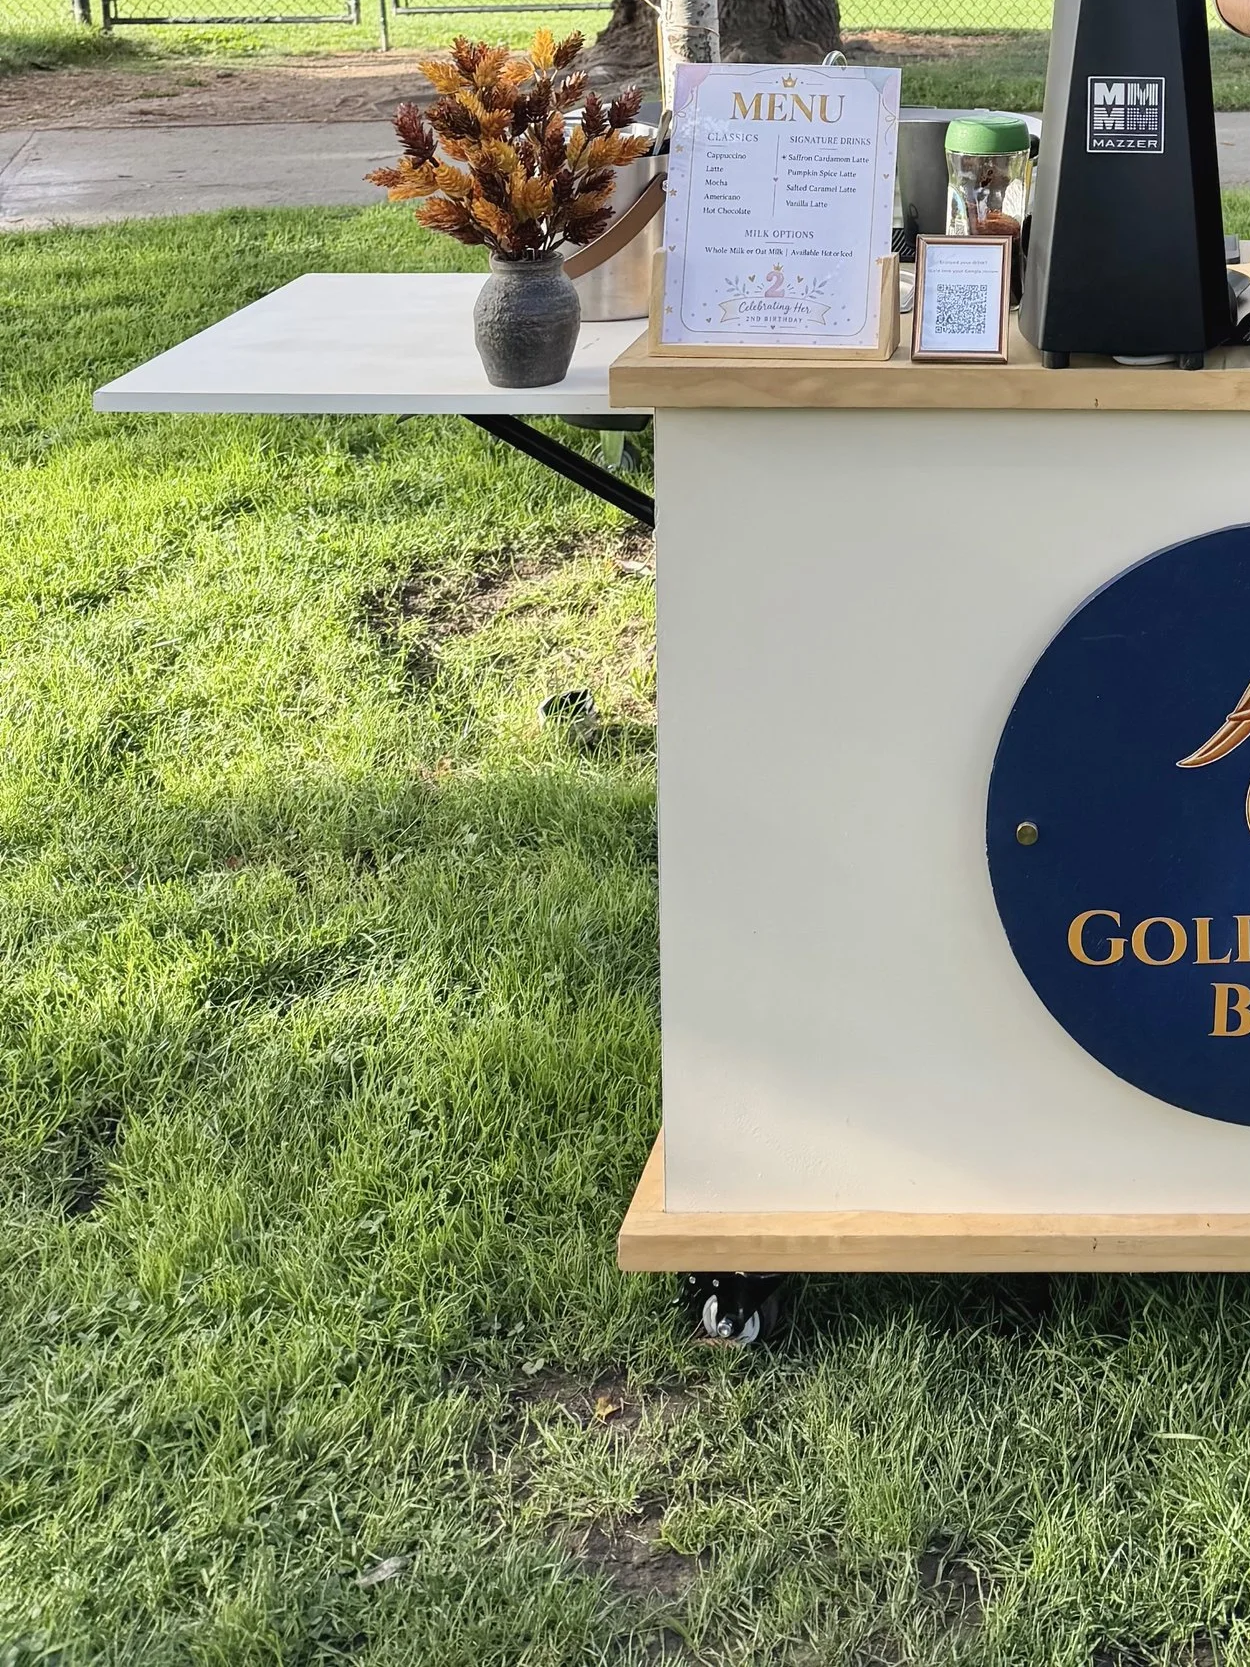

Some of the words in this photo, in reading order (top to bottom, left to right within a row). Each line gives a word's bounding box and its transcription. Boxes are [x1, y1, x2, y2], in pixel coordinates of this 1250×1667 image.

[729, 91, 845, 124] MENU
[707, 132, 759, 143] CLASSICS
[789, 135, 838, 145] SIGNATURE
[840, 137, 871, 146] DRINKS
[1093, 139, 1158, 148] MAZZER
[706, 151, 747, 161] Cappuccino
[788, 153, 813, 162] Saffron
[814, 154, 851, 163] Cardamom
[852, 156, 870, 164] Latte
[706, 165, 724, 173] Latte
[787, 168, 818, 178] Pumpkin
[819, 169, 838, 179] Spice
[839, 170, 857, 178] Latte
[705, 178, 728, 187] Mocha
[786, 184, 808, 192] Salted
[809, 184, 838, 193] Caramel
[839, 185, 857, 194] Latte
[704, 193, 741, 201] Americano
[785, 200, 809, 208] Vanilla
[810, 200, 828, 208] Latte
[703, 207, 717, 215] Hot
[717, 207, 751, 215] Chocolate
[744, 229, 769, 238] MILK
[772, 230, 815, 239] OPTIONS
[705, 246, 728, 254] Whole
[729, 247, 745, 255] Milk
[768, 248, 783, 256] Milk
[791, 249, 820, 257] Available
[764, 270, 785, 298] 2
[738, 300, 792, 315] Celebrating
[793, 302, 812, 315] Her
